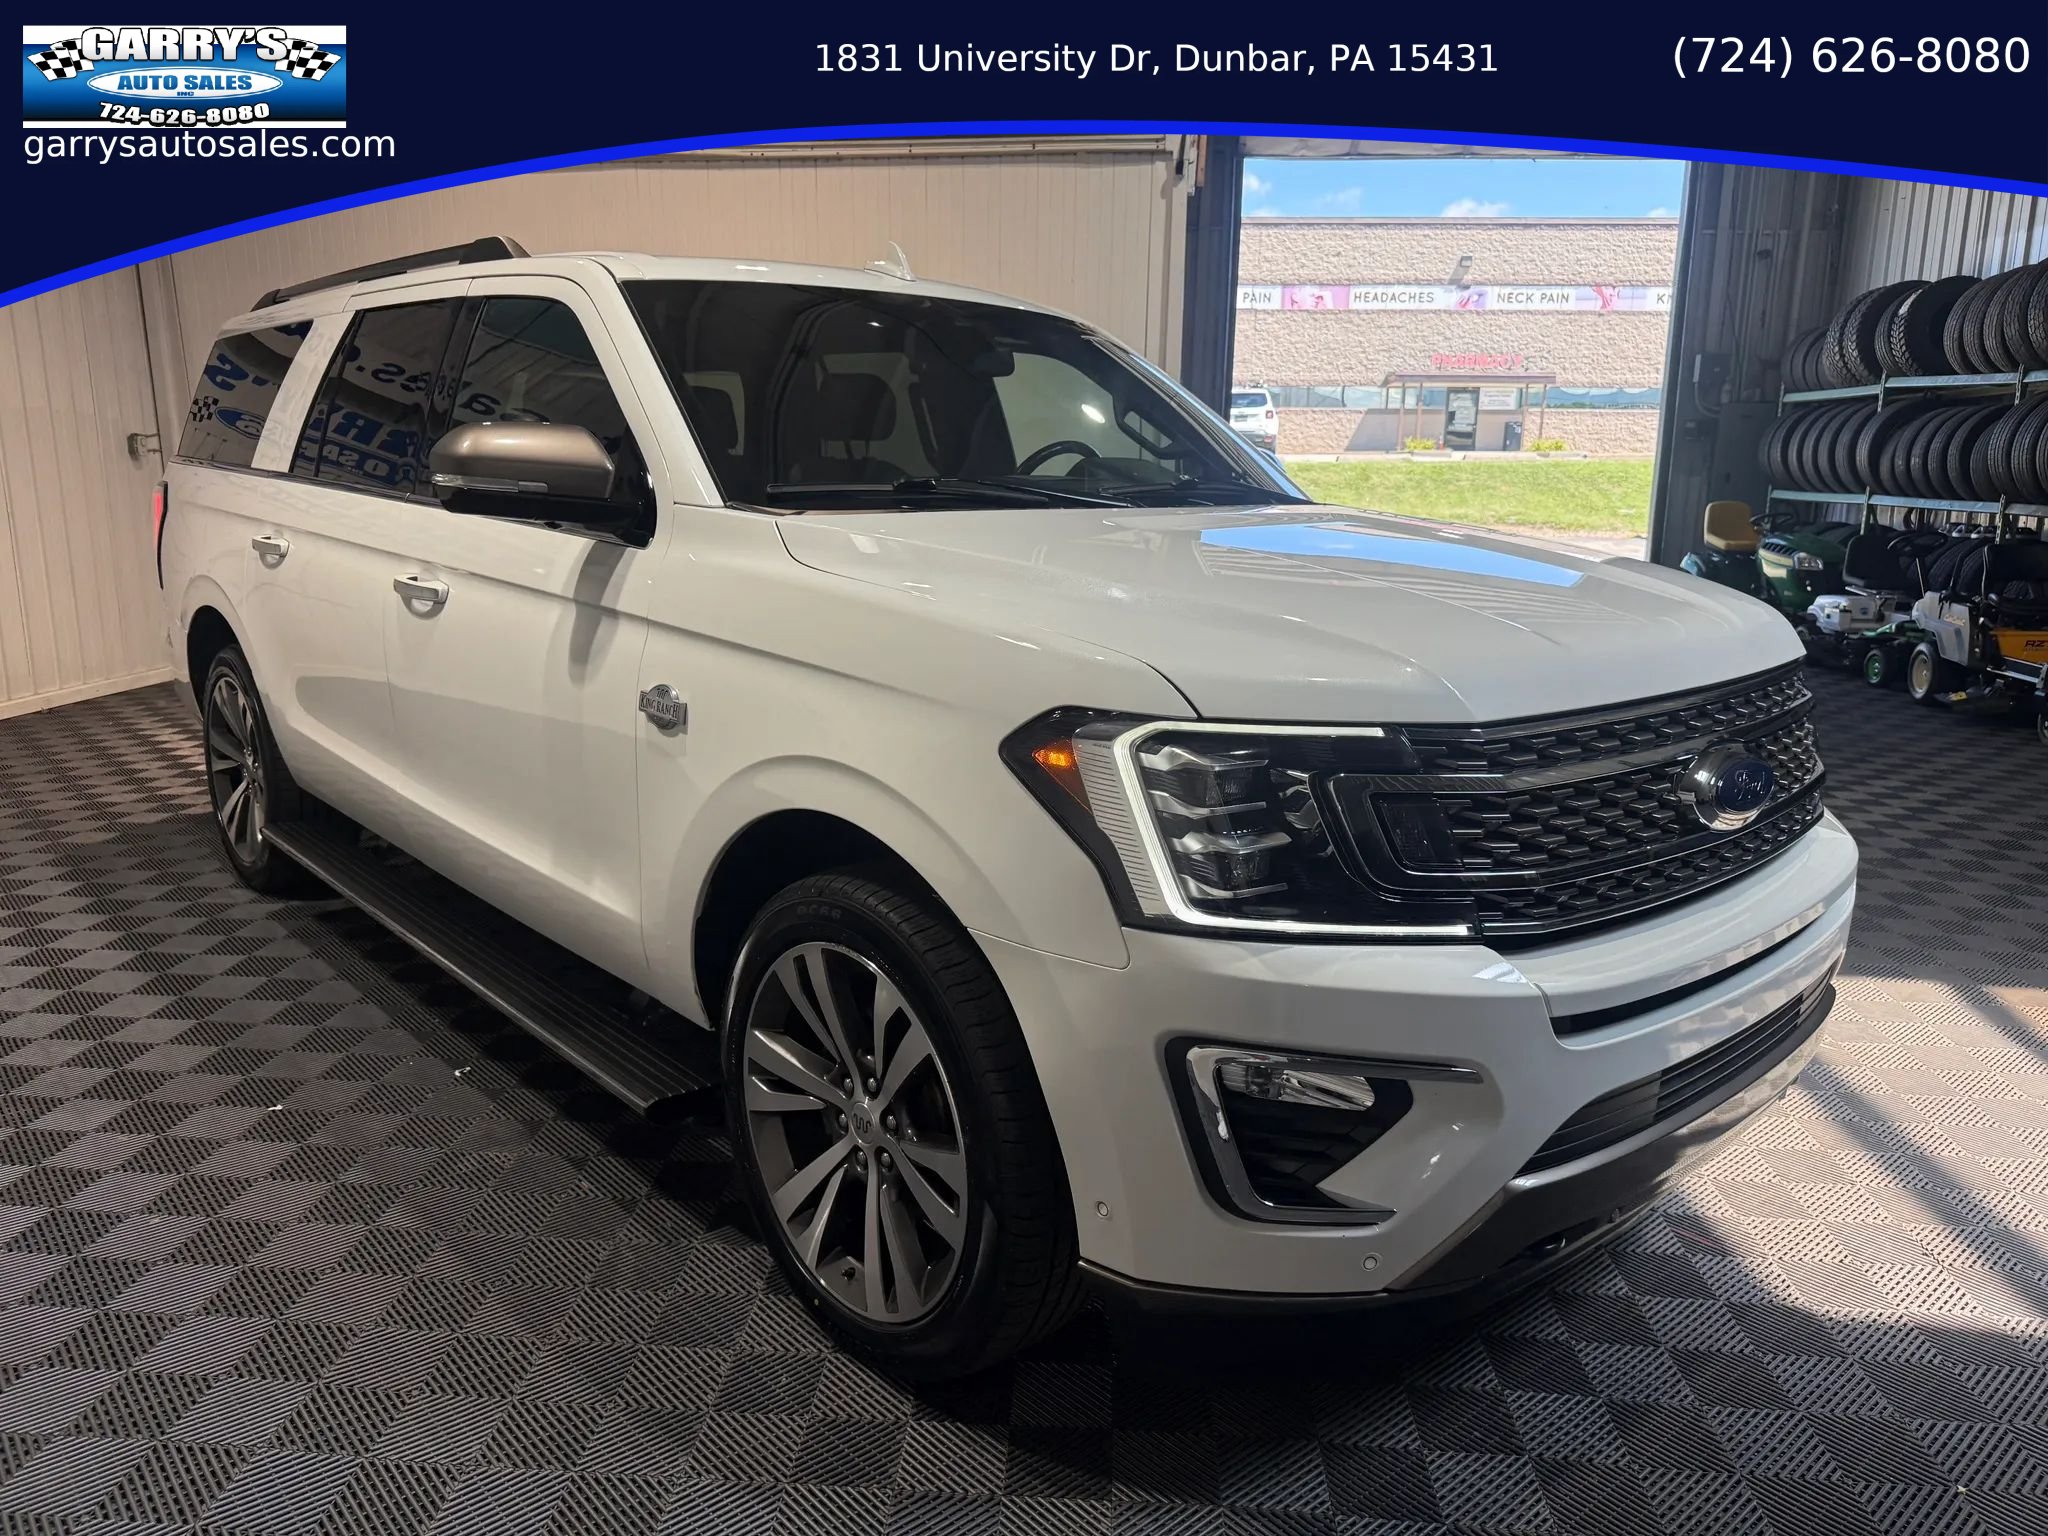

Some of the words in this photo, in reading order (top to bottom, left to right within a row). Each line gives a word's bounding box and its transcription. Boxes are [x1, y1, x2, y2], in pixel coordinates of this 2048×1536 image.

[1243, 292, 1272, 303] PAIN
[1354, 292, 1435, 304] HEADACHES
[1497, 292, 1534, 305] NECK
[1540, 293, 1570, 304] PAIN
